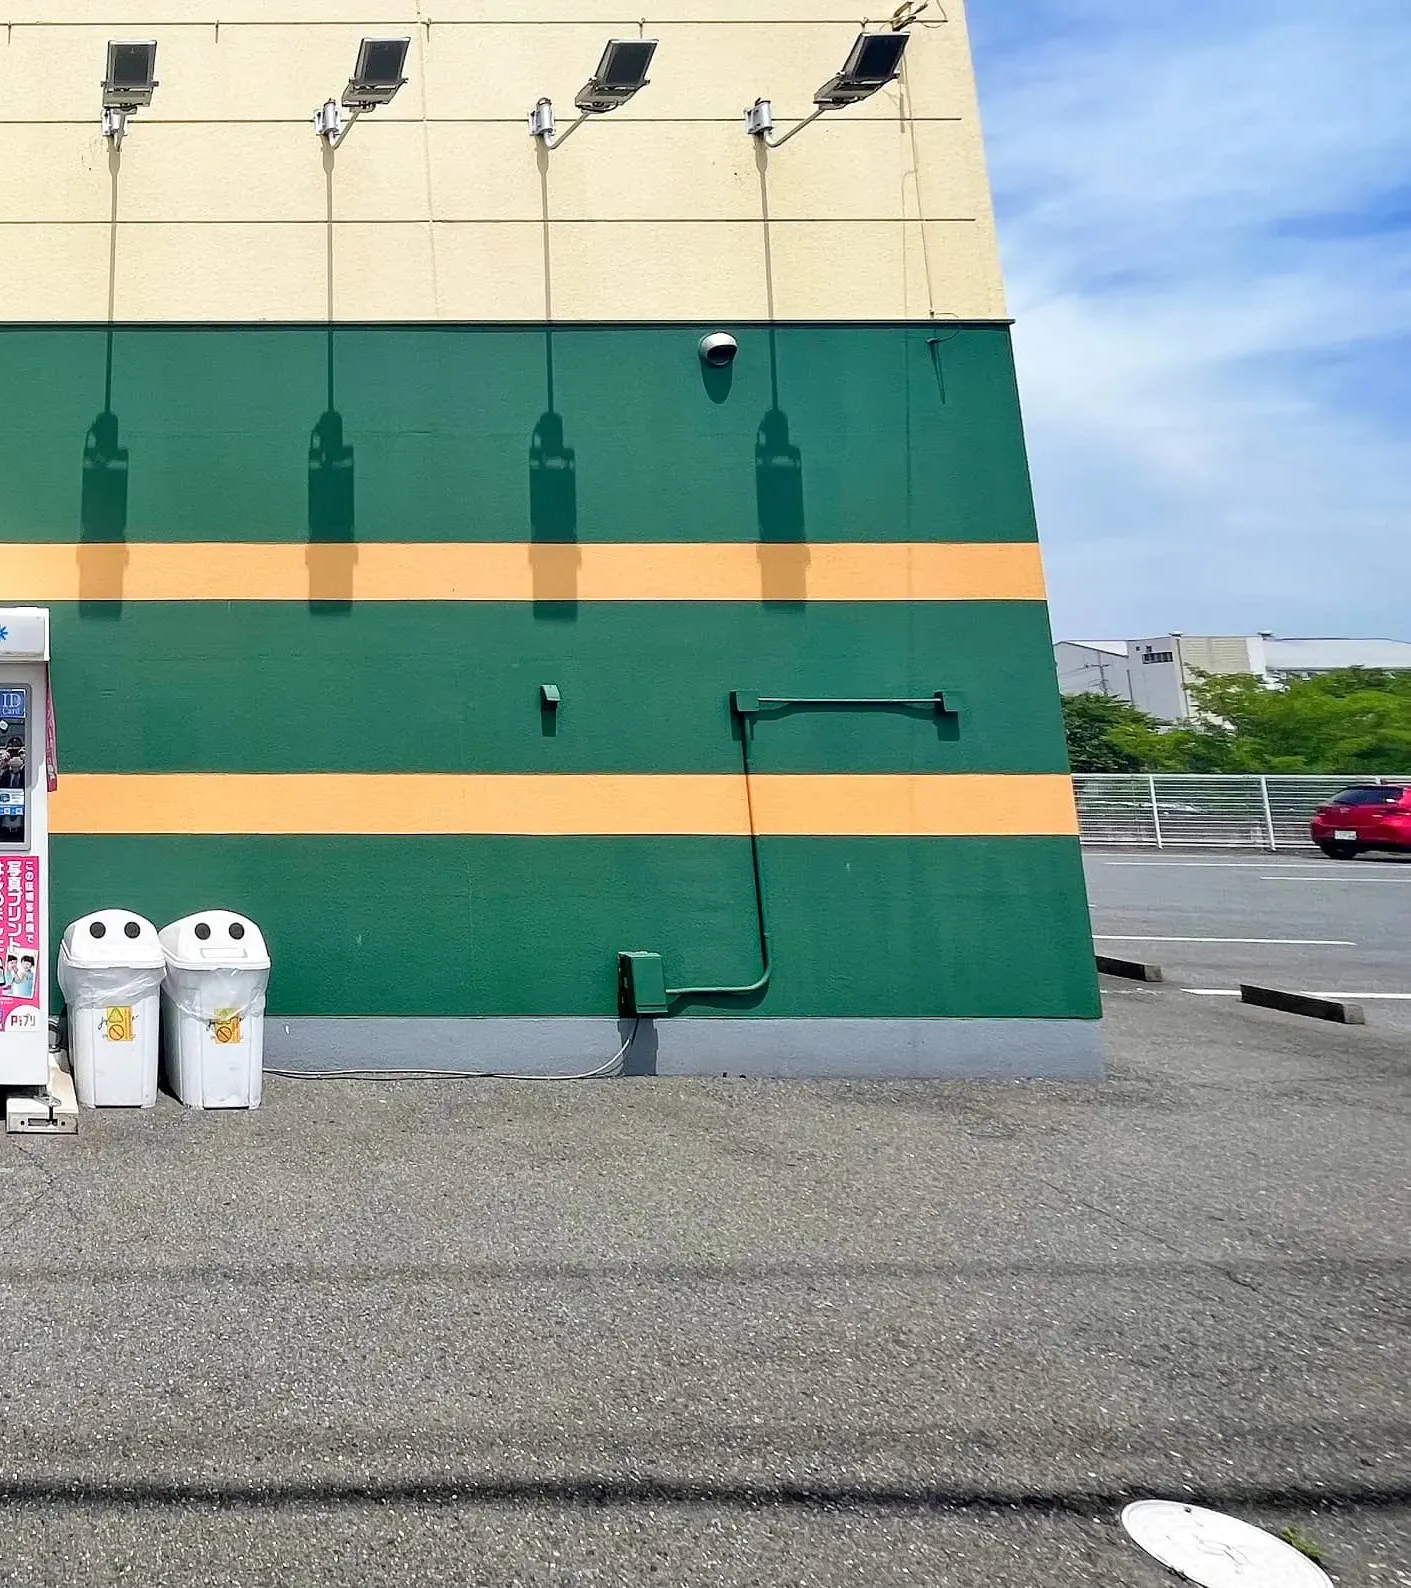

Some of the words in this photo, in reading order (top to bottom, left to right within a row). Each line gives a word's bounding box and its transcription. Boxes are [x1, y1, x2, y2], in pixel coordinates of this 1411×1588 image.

[2, 693, 22, 708] ID
[2, 707, 21, 715] Card
[7, 860, 23, 953] 写真プリント
